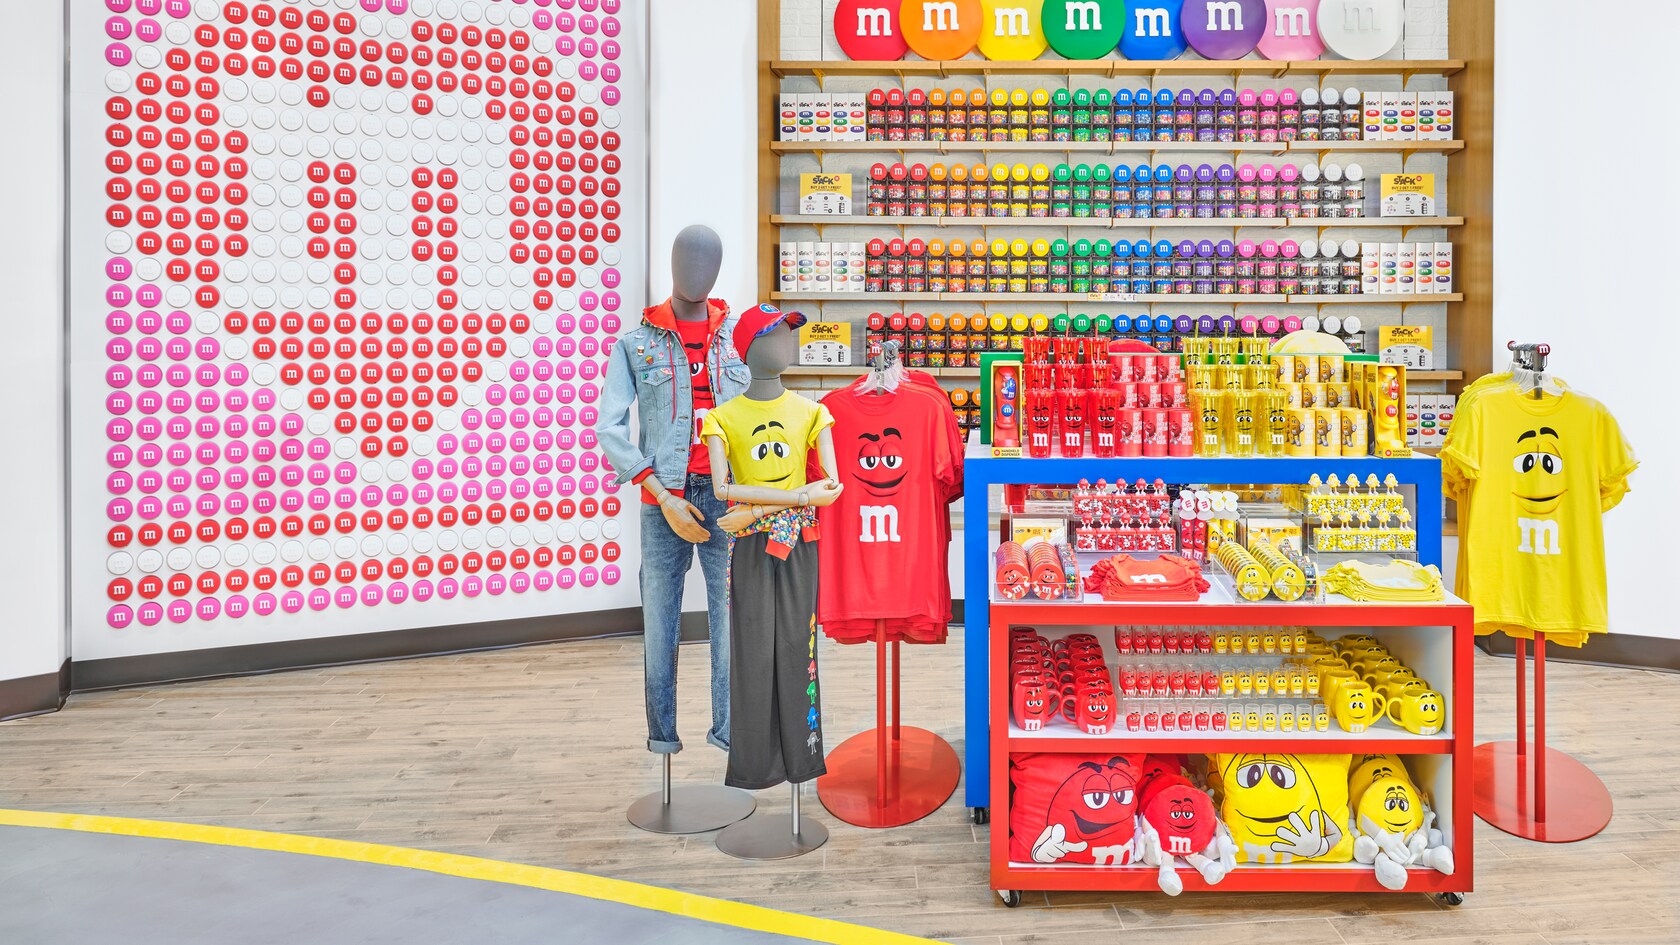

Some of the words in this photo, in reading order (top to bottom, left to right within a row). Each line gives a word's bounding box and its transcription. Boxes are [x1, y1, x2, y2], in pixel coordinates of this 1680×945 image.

[922, 2, 959, 31] m
[1065, 2, 1102, 31] m
[1206, 1, 1243, 31] m
[1344, 0, 1381, 30] m
[313, 16, 323, 24] m
[856, 8, 892, 36] m
[994, 7, 1030, 36] m
[1135, 7, 1171, 37] m
[1274, 7, 1311, 36] m
[142, 25, 153, 34] m
[286, 38, 296, 47] m
[286, 64, 296, 73] m
[392, 72, 402, 80] m
[516, 83, 524, 91] m
[143, 106, 154, 114] m
[540, 156, 548, 164] m
[313, 168, 324, 176] m
[813, 176, 834, 184] STACK
[1394, 176, 1415, 185] STACK
[314, 193, 324, 201] m
[314, 218, 324, 226] m
[340, 244, 350, 252] m
[113, 264, 124, 272] m
[287, 318, 297, 326] m
[812, 324, 832, 333] STACK
[1392, 328, 1413, 337] STACK
[286, 344, 297, 352] m
[340, 344, 350, 352] m
[1539, 344, 1548, 353] m
[314, 370, 324, 378] m
[231, 396, 241, 404] m
[113, 426, 124, 434] m
[231, 422, 241, 430] m
[1033, 433, 1048, 446] m
[1065, 433, 1080, 446] m
[1098, 433, 1113, 446] m
[1205, 434, 1217, 444] m
[1239, 434, 1251, 444] m
[1272, 434, 1284, 444] m
[393, 442, 403, 450] m
[231, 474, 241, 482] m
[114, 506, 125, 514] m
[144, 504, 154, 512] m
[340, 518, 350, 527] m
[860, 505, 901, 542] m
[259, 524, 270, 532] m
[1517, 517, 1561, 555] m
[393, 565, 403, 573] m
[419, 587, 428, 595] m
[1013, 584, 1022, 593] m
[232, 602, 242, 611] m
[1024, 719, 1041, 730] m
[1087, 724, 1106, 734] m
[1169, 834, 1193, 853] m
